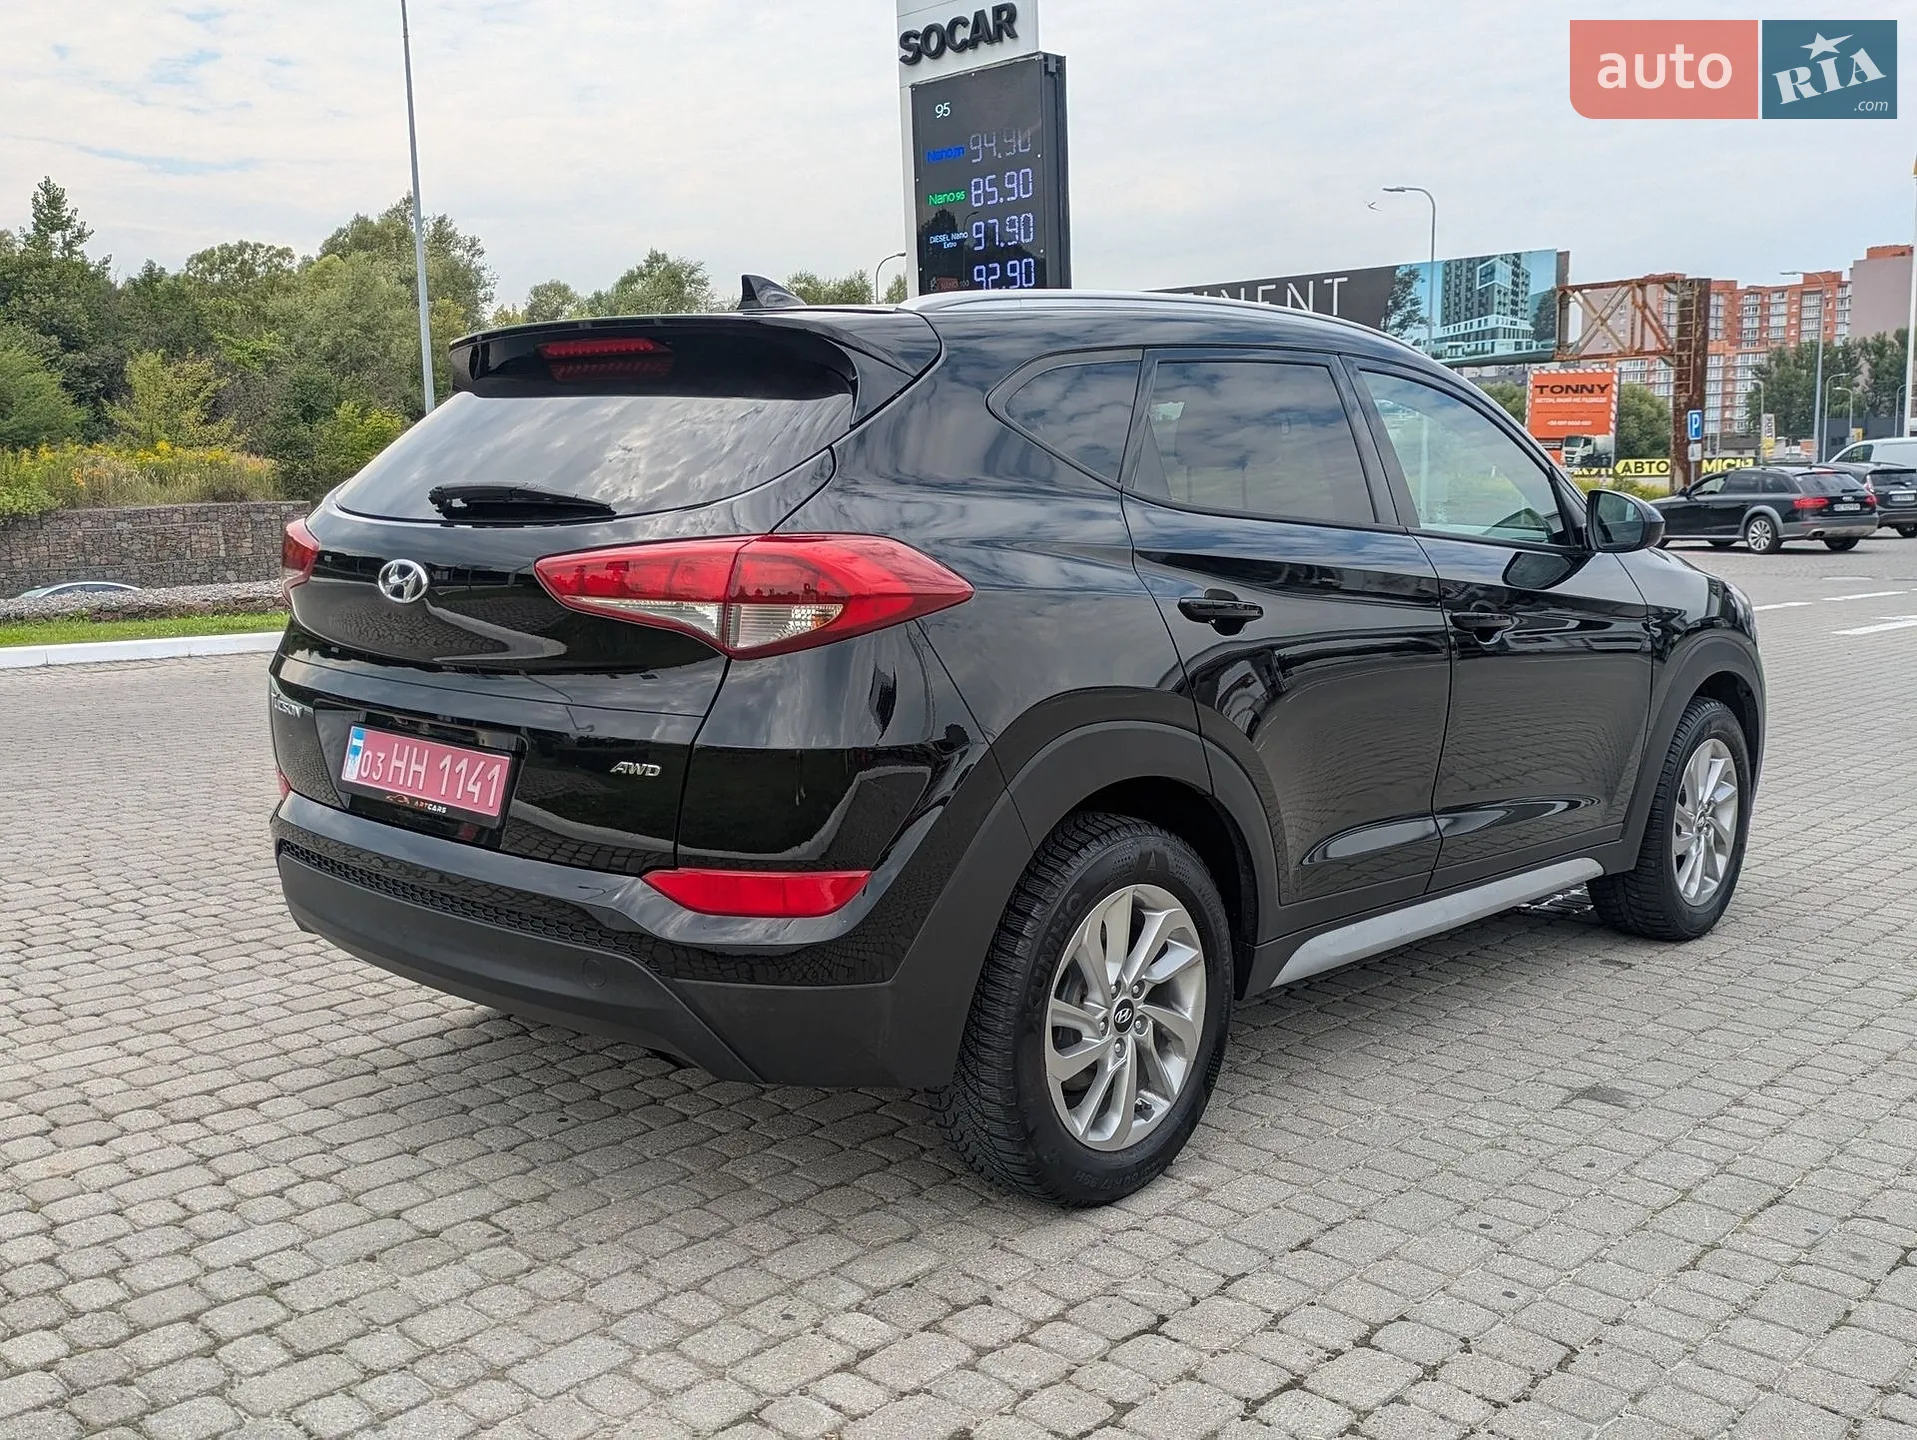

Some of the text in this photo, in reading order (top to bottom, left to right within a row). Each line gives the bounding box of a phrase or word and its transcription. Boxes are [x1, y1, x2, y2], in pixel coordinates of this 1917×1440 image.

[899, 2, 1018, 66] SOCAR
[935, 102, 951, 118] 95
[971, 167, 1033, 207] 85.90
[929, 234, 950, 244] DIESEL
[972, 213, 1034, 251] 97.90
[974, 258, 1035, 290] 92.90
[1534, 383, 1610, 395] TONNY
[1692, 413, 1700, 437] P
[1621, 460, 1669, 474] АВТО
[360, 743, 502, 808] 03 HH 1141
[609, 761, 661, 777] AWD
